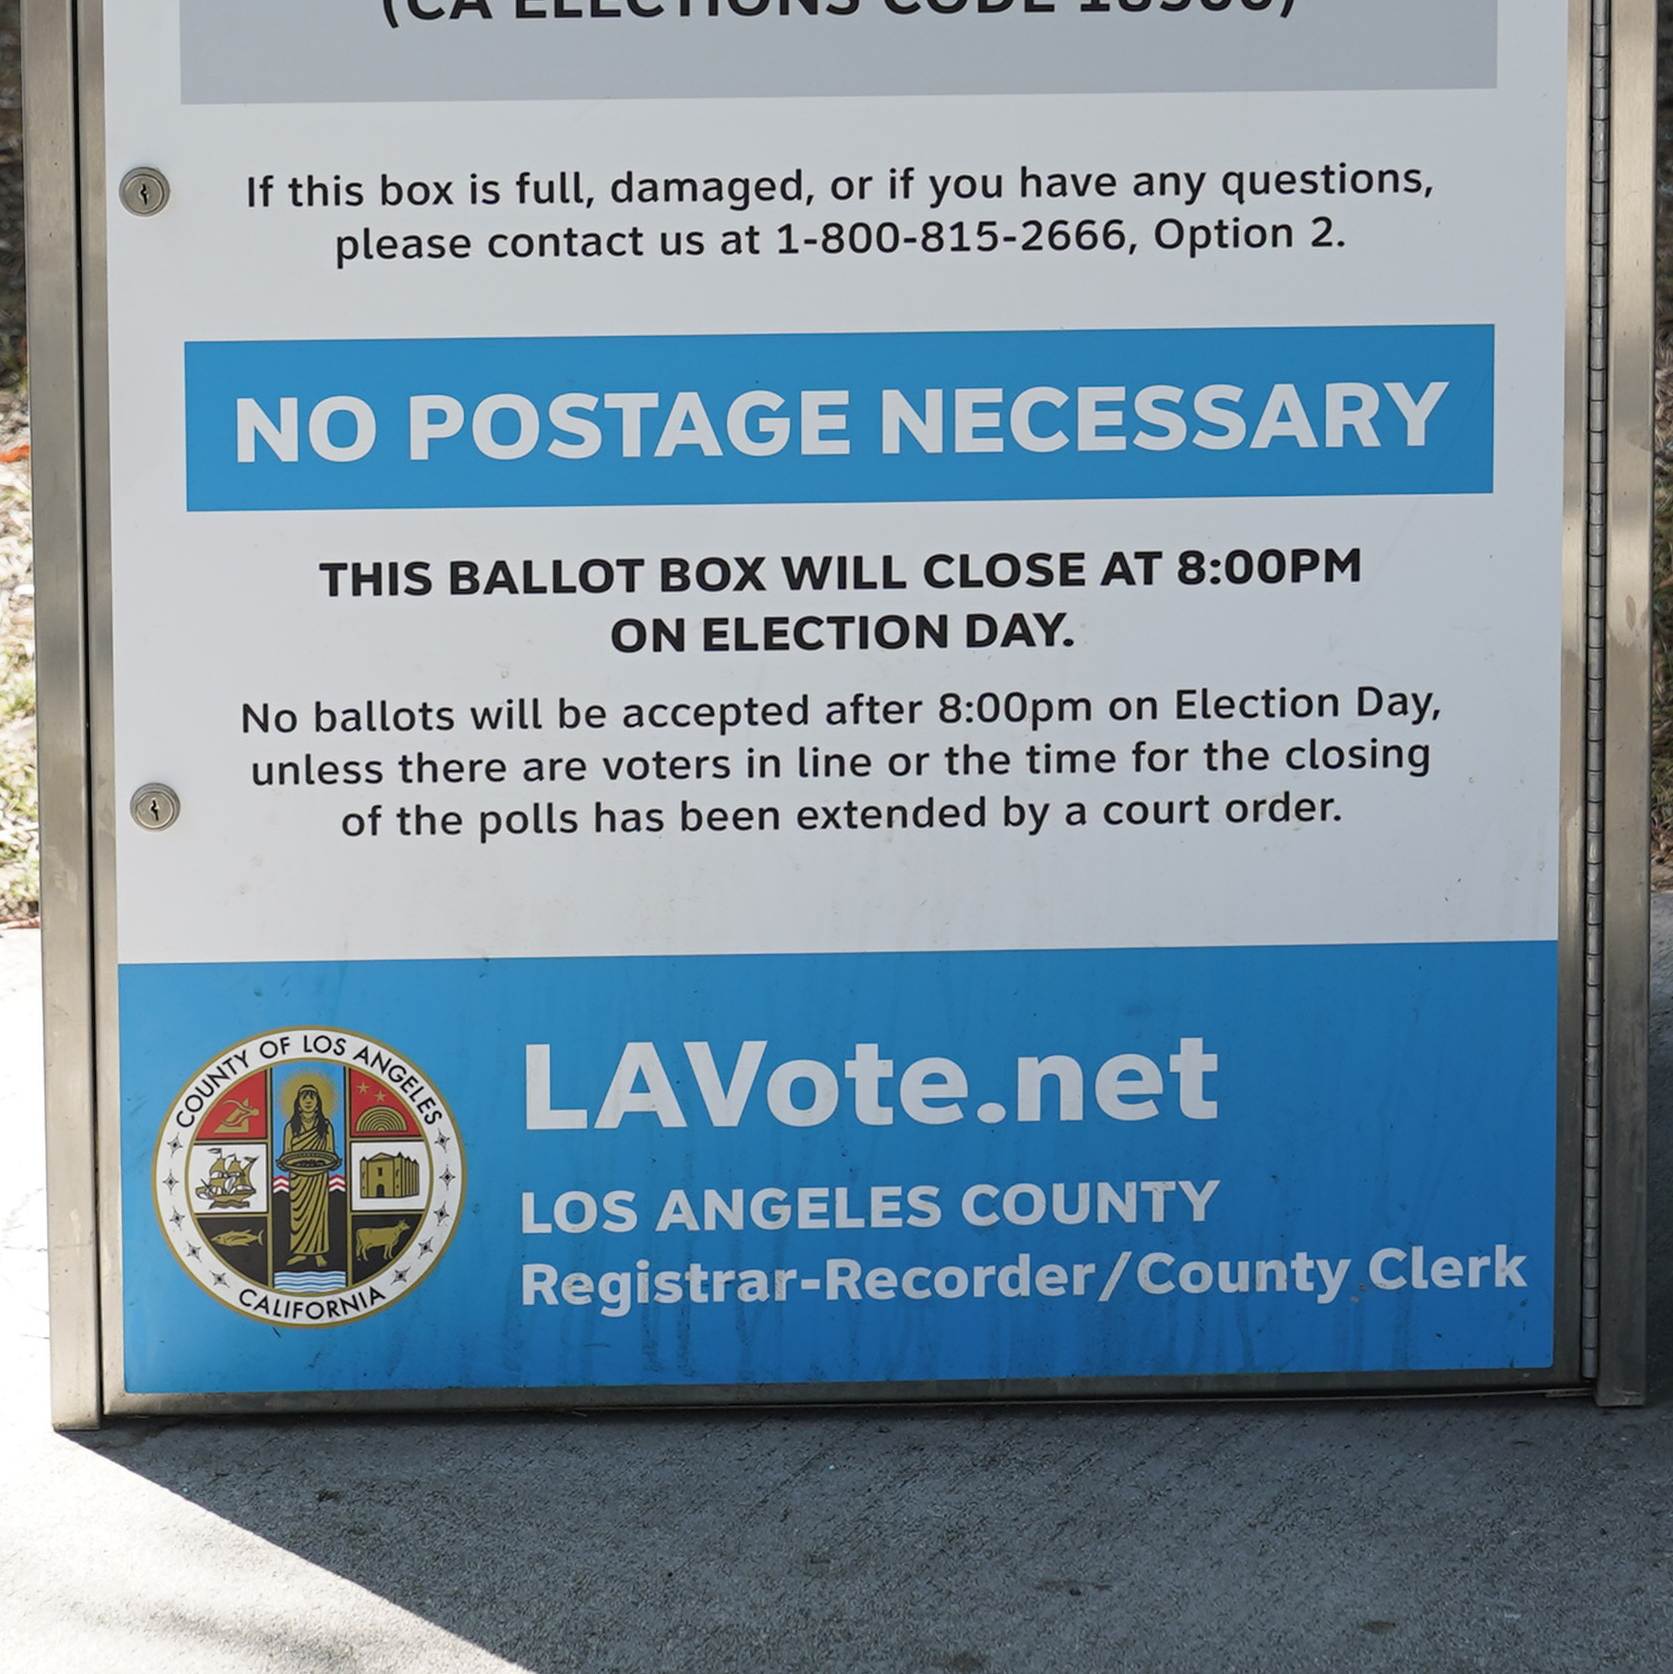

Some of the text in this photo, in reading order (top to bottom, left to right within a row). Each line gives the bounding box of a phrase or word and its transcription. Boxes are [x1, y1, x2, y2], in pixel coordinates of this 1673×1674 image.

[248, 161, 1433, 212] If this box is full, damaged, or if you have any questions,
[336, 215, 1345, 270] please contact us at 1-800-815-2666, Option 2.
[236, 381, 1450, 463] NO POSTAGE NECESSARY
[318, 547, 1361, 597] THIS BALLOT BOX WILL CLOSE AT 8:00PM
[611, 612, 1075, 654] ON ELECTION DAY.
[242, 685, 1441, 736] No ballots will be accepted after 8:00pm on Election Day,
[252, 737, 1430, 786] unless there are voters in line or the time for the closing
[342, 790, 1342, 844] of the polls has been extended by a court order.
[176, 1034, 443, 1128] COUNTY OF LOS ANGELES
[525, 1037, 1218, 1131] LAVote.net
[521, 1179, 1221, 1234] LOS ANGELES COUNTY
[239, 1286, 386, 1320] CALIFORNIA
[522, 1244, 1528, 1318] Registrar-Recorder/County Clerk
